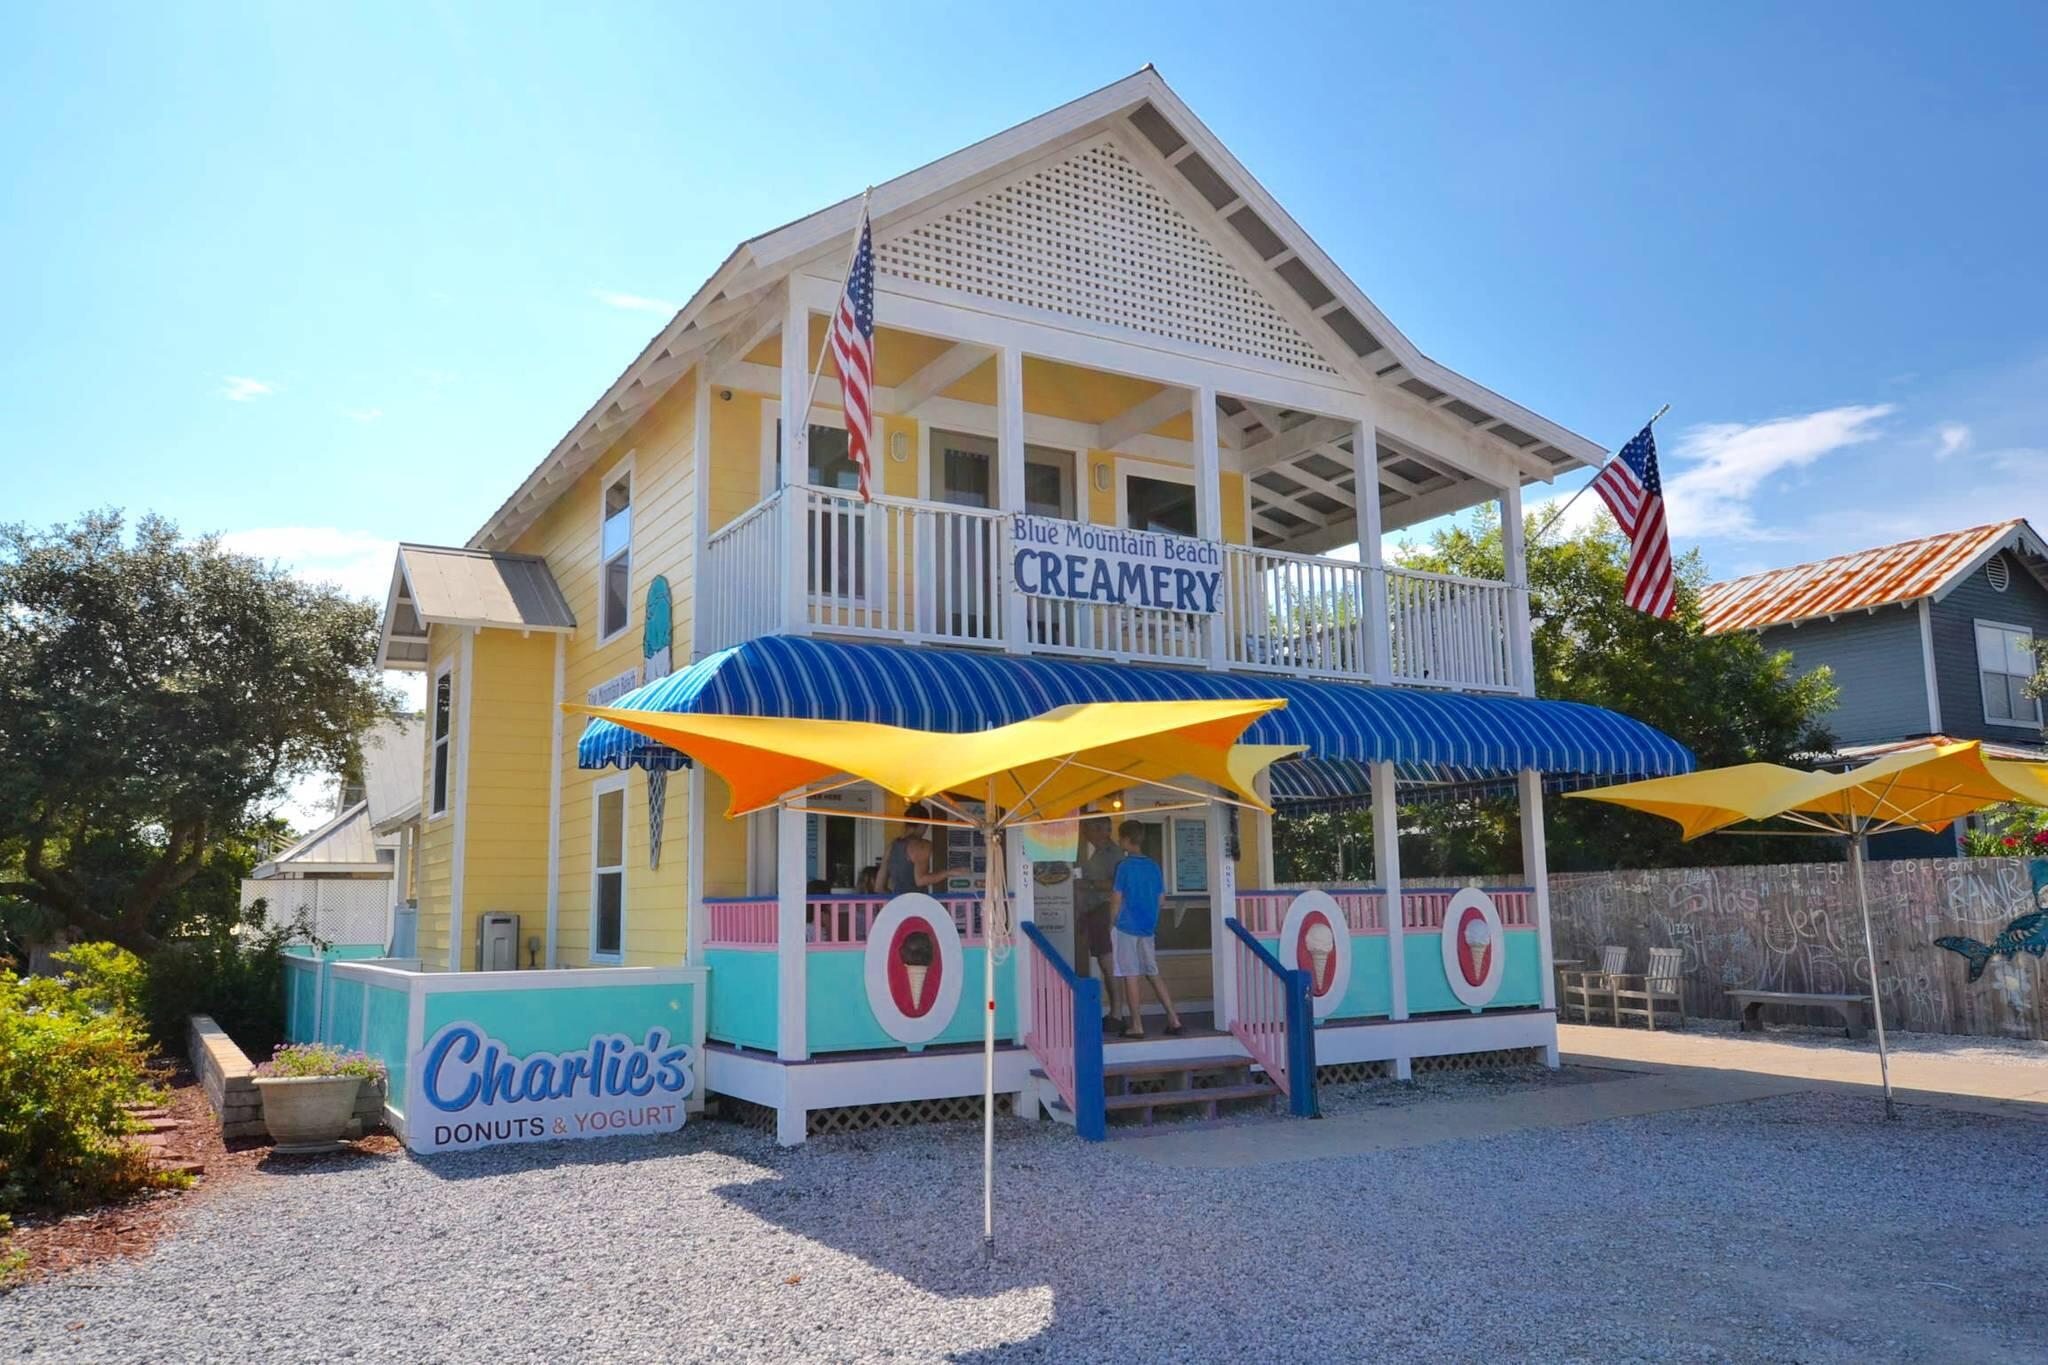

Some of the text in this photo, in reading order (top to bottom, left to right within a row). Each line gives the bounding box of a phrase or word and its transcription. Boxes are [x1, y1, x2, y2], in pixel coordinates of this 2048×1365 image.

[1014, 518, 1218, 565] Blue Mountain Beach
[1014, 548, 1221, 613] CREAMERY
[423, 1027, 687, 1113] Charlie's
[434, 1105, 677, 1145] DONUTS & YOGURT
